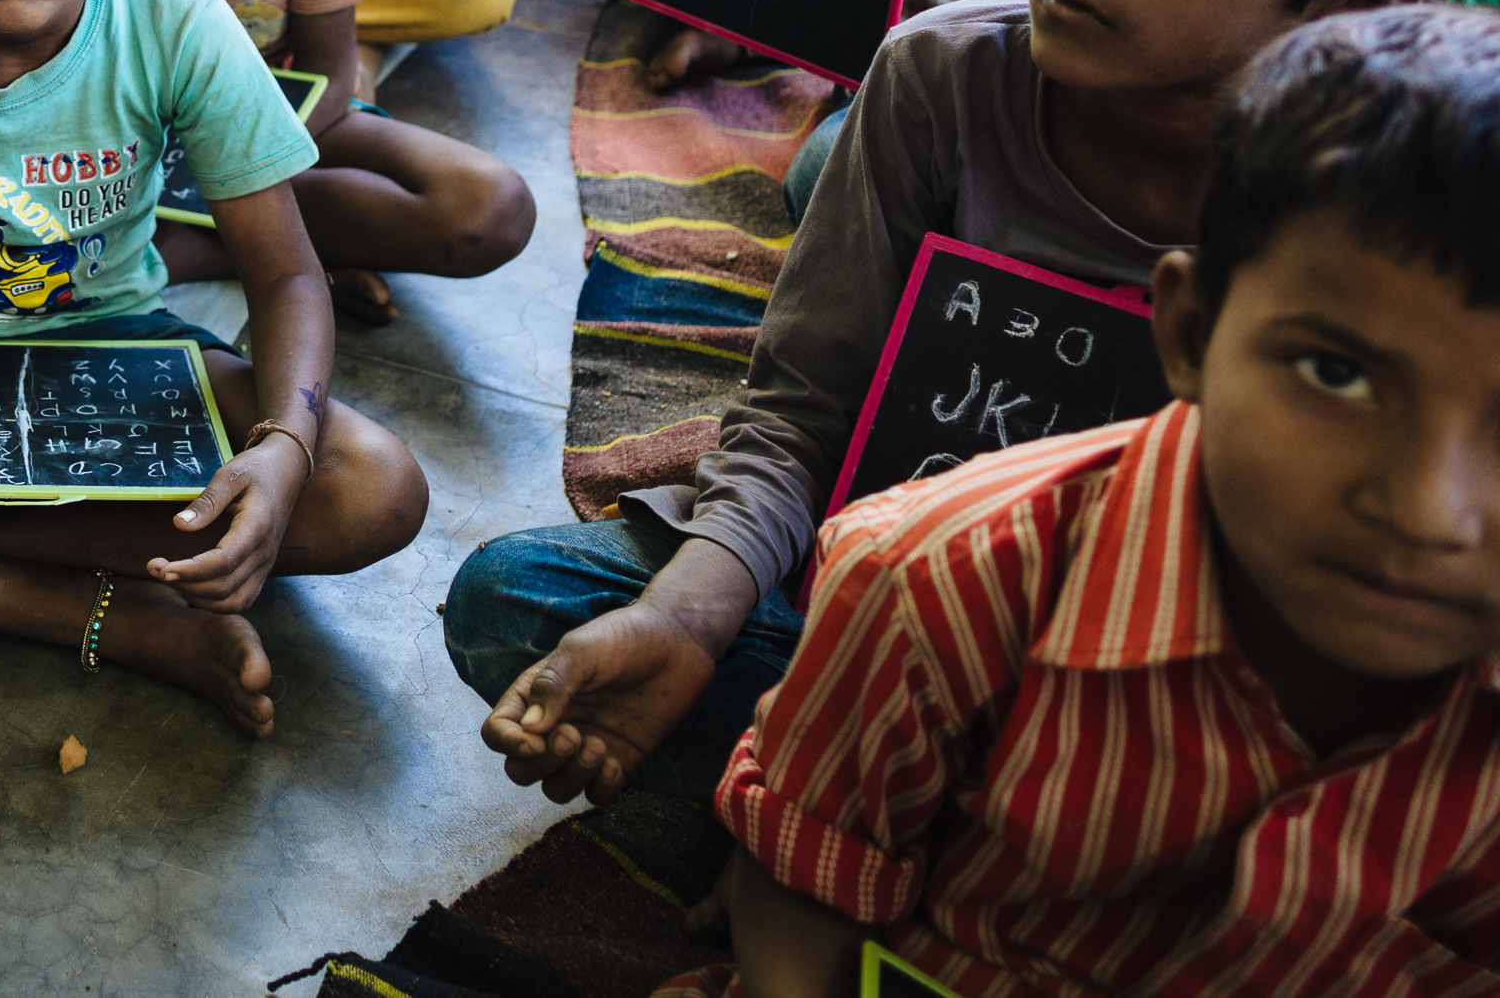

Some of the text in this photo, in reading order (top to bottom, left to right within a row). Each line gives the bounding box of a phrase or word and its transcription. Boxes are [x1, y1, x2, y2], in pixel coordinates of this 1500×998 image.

[21, 139, 140, 187] HOBBY
[59, 172, 136, 210] DO YOU
[68, 193, 126, 231] HEAR
[945, 280, 980, 325] A
